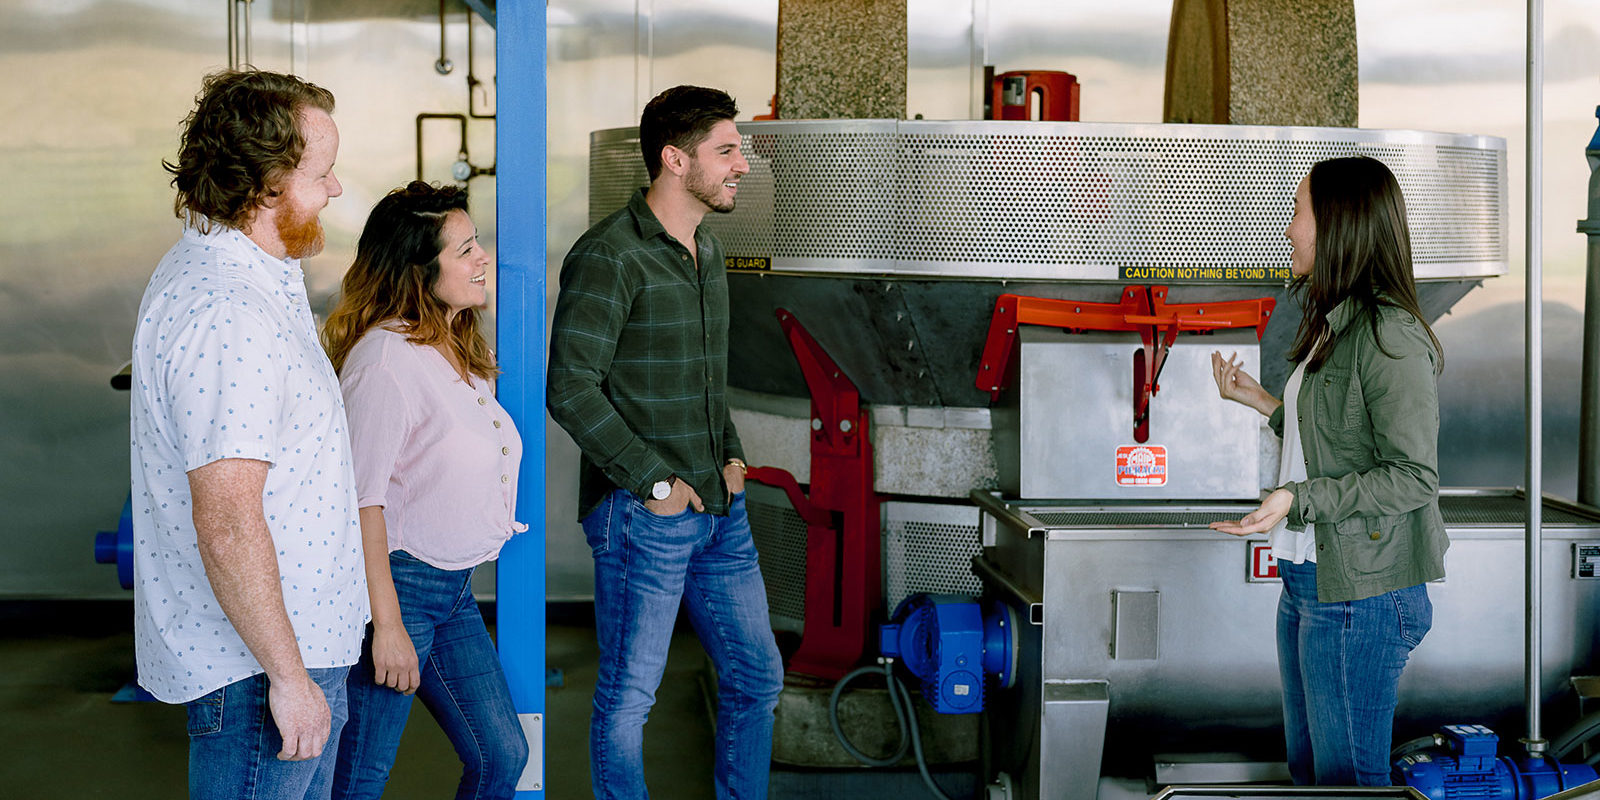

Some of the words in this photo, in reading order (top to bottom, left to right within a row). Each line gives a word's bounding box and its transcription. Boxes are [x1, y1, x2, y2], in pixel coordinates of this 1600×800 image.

[737, 258, 766, 269] GUARD
[1125, 267, 1175, 279] CAUTION
[1177, 268, 1223, 279] NOTHING
[1225, 268, 1265, 279] BEYOND
[1268, 268, 1290, 279] THIS
